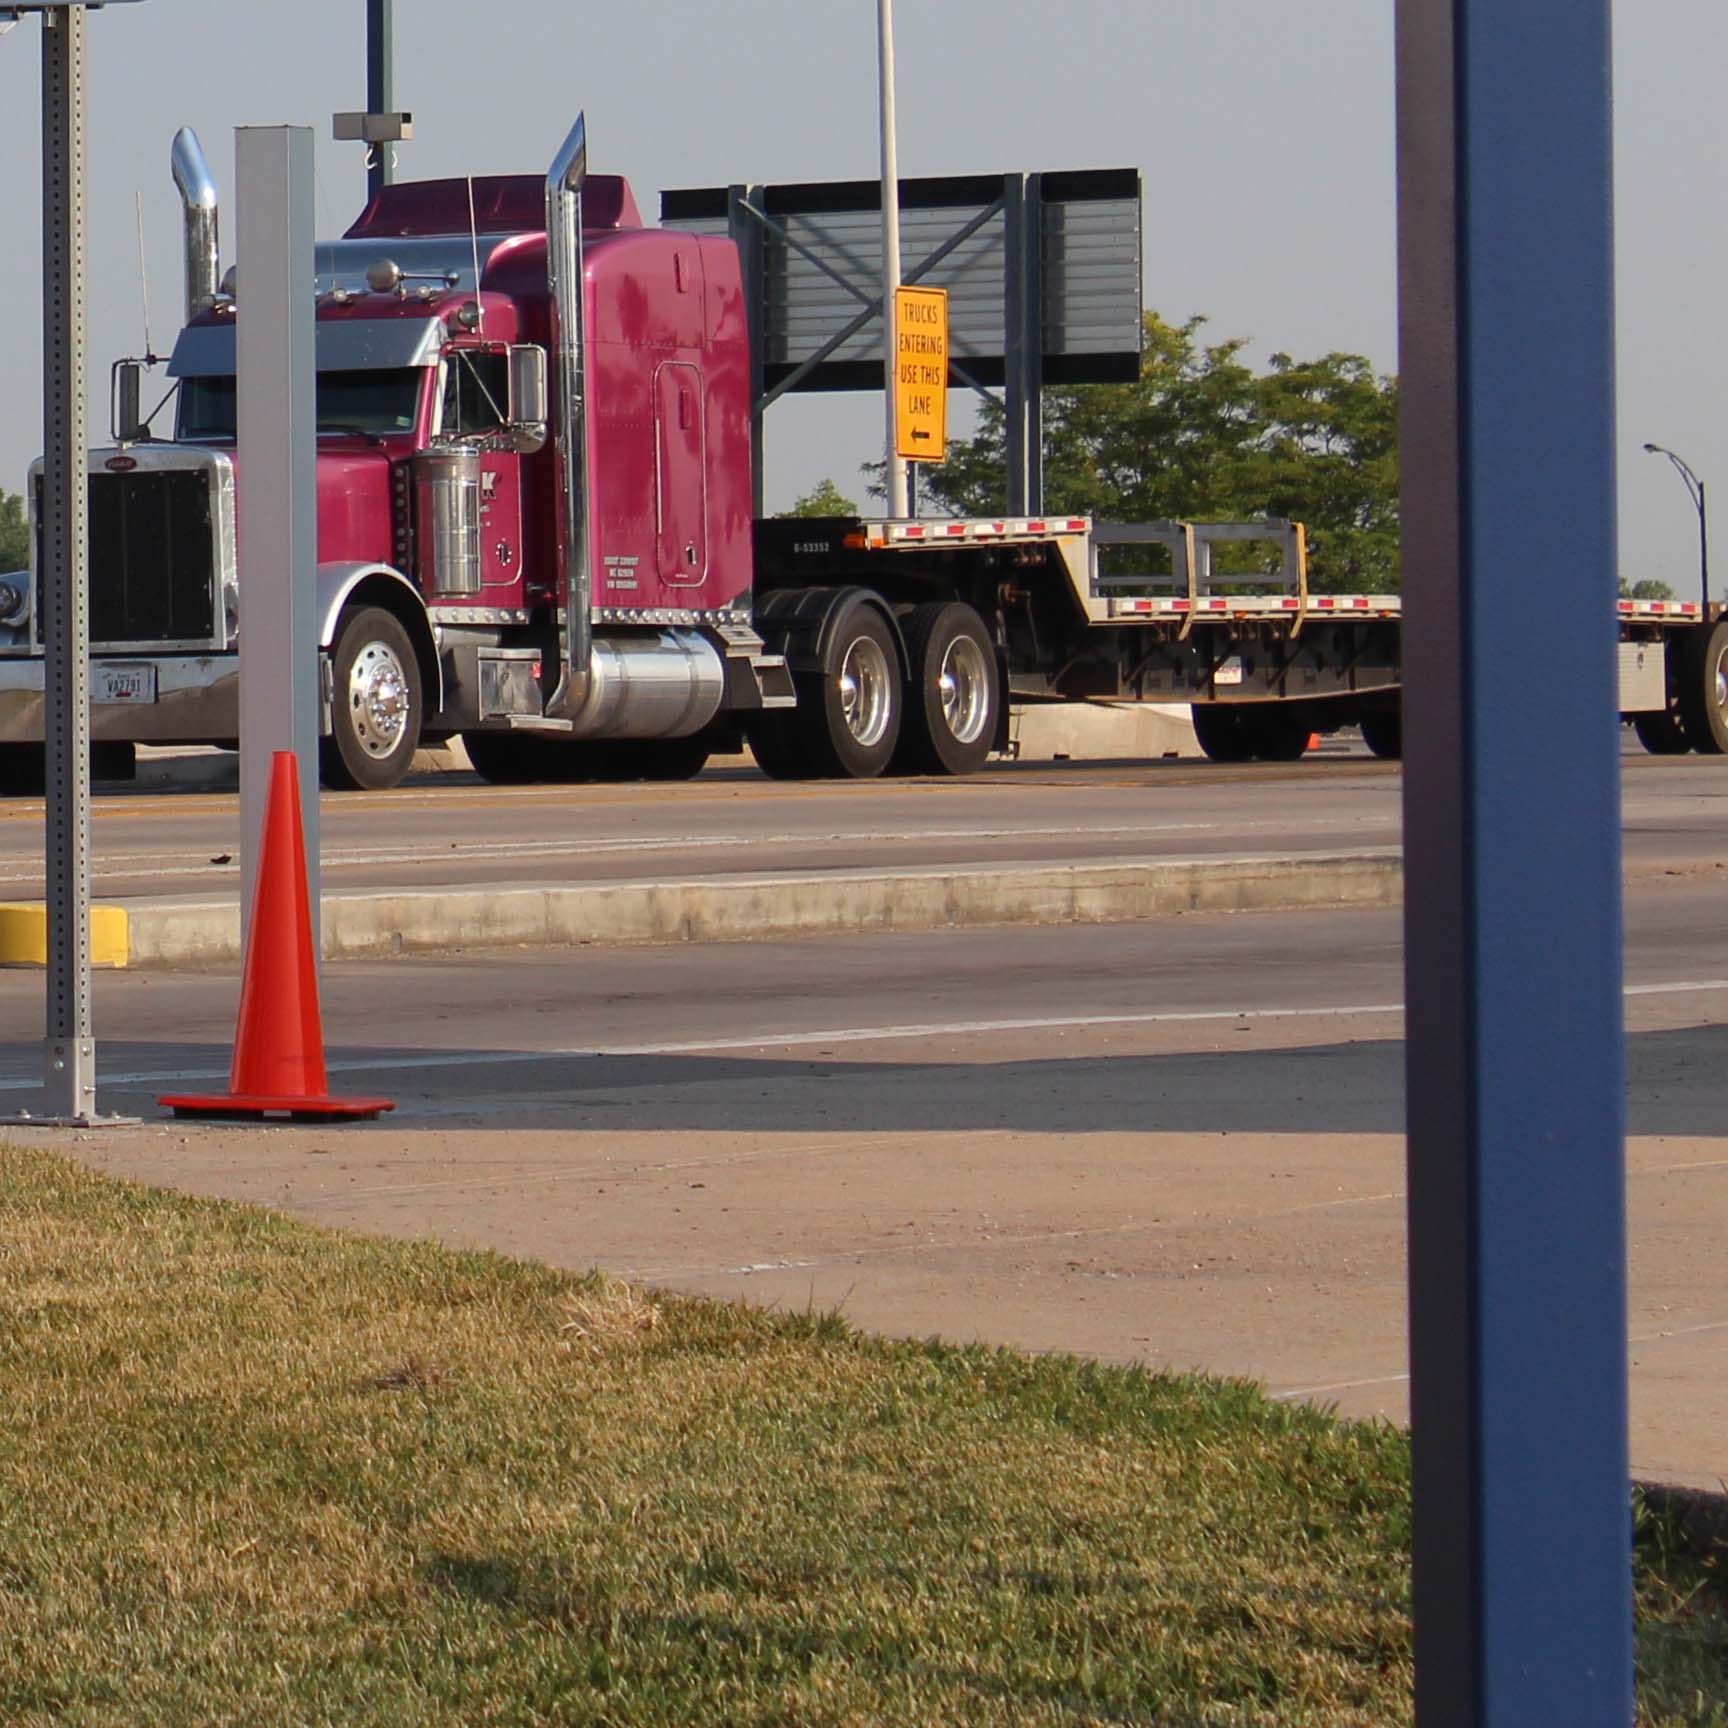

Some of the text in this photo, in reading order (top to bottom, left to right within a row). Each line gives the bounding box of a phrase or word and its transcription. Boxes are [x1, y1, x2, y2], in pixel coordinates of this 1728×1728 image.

[904, 303, 938, 324] TRUCKS
[900, 333, 943, 355] ENTERING
[901, 364, 940, 386] USE THIS
[909, 394, 931, 415] LANE
